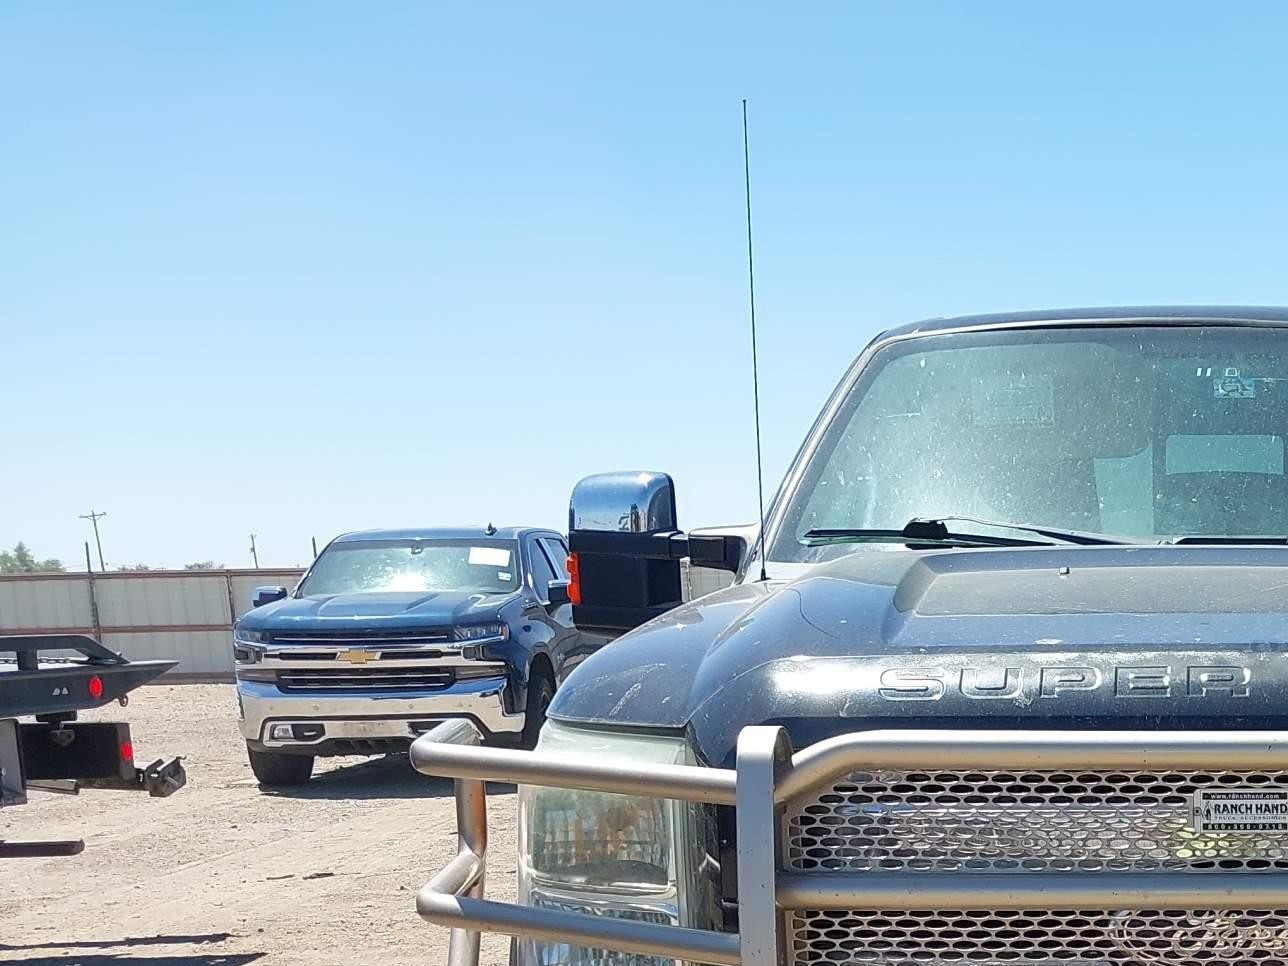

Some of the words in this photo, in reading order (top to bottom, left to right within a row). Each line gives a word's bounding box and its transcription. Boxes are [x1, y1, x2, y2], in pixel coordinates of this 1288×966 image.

[877, 663, 1252, 701] SUPER
[1214, 803, 1253, 814] RANCH
[1255, 803, 1288, 814] HAND
